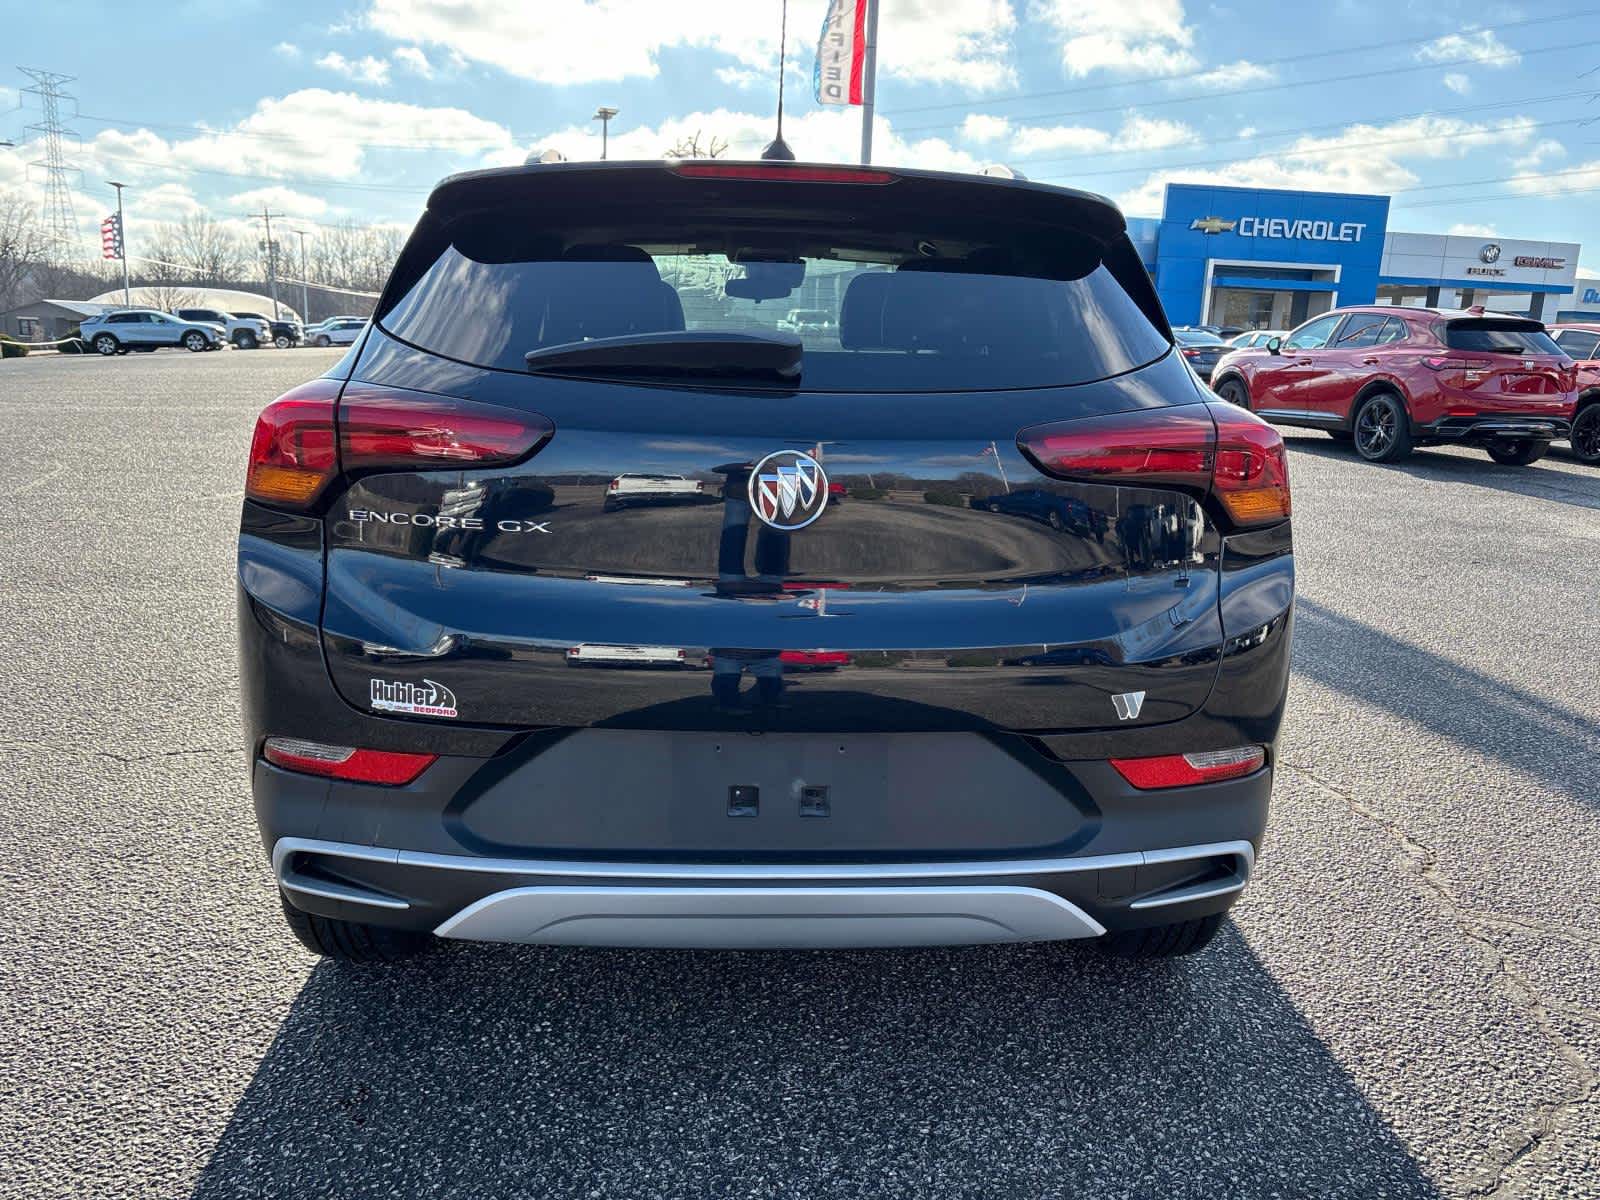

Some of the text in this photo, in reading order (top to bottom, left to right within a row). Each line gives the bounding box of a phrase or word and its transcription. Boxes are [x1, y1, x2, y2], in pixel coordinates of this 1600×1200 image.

[1239, 217, 1366, 242] CHEVROLET
[349, 509, 552, 534] ENCORE GX
[371, 679, 434, 706] Hubler
[413, 705, 457, 716] BEDFORD
